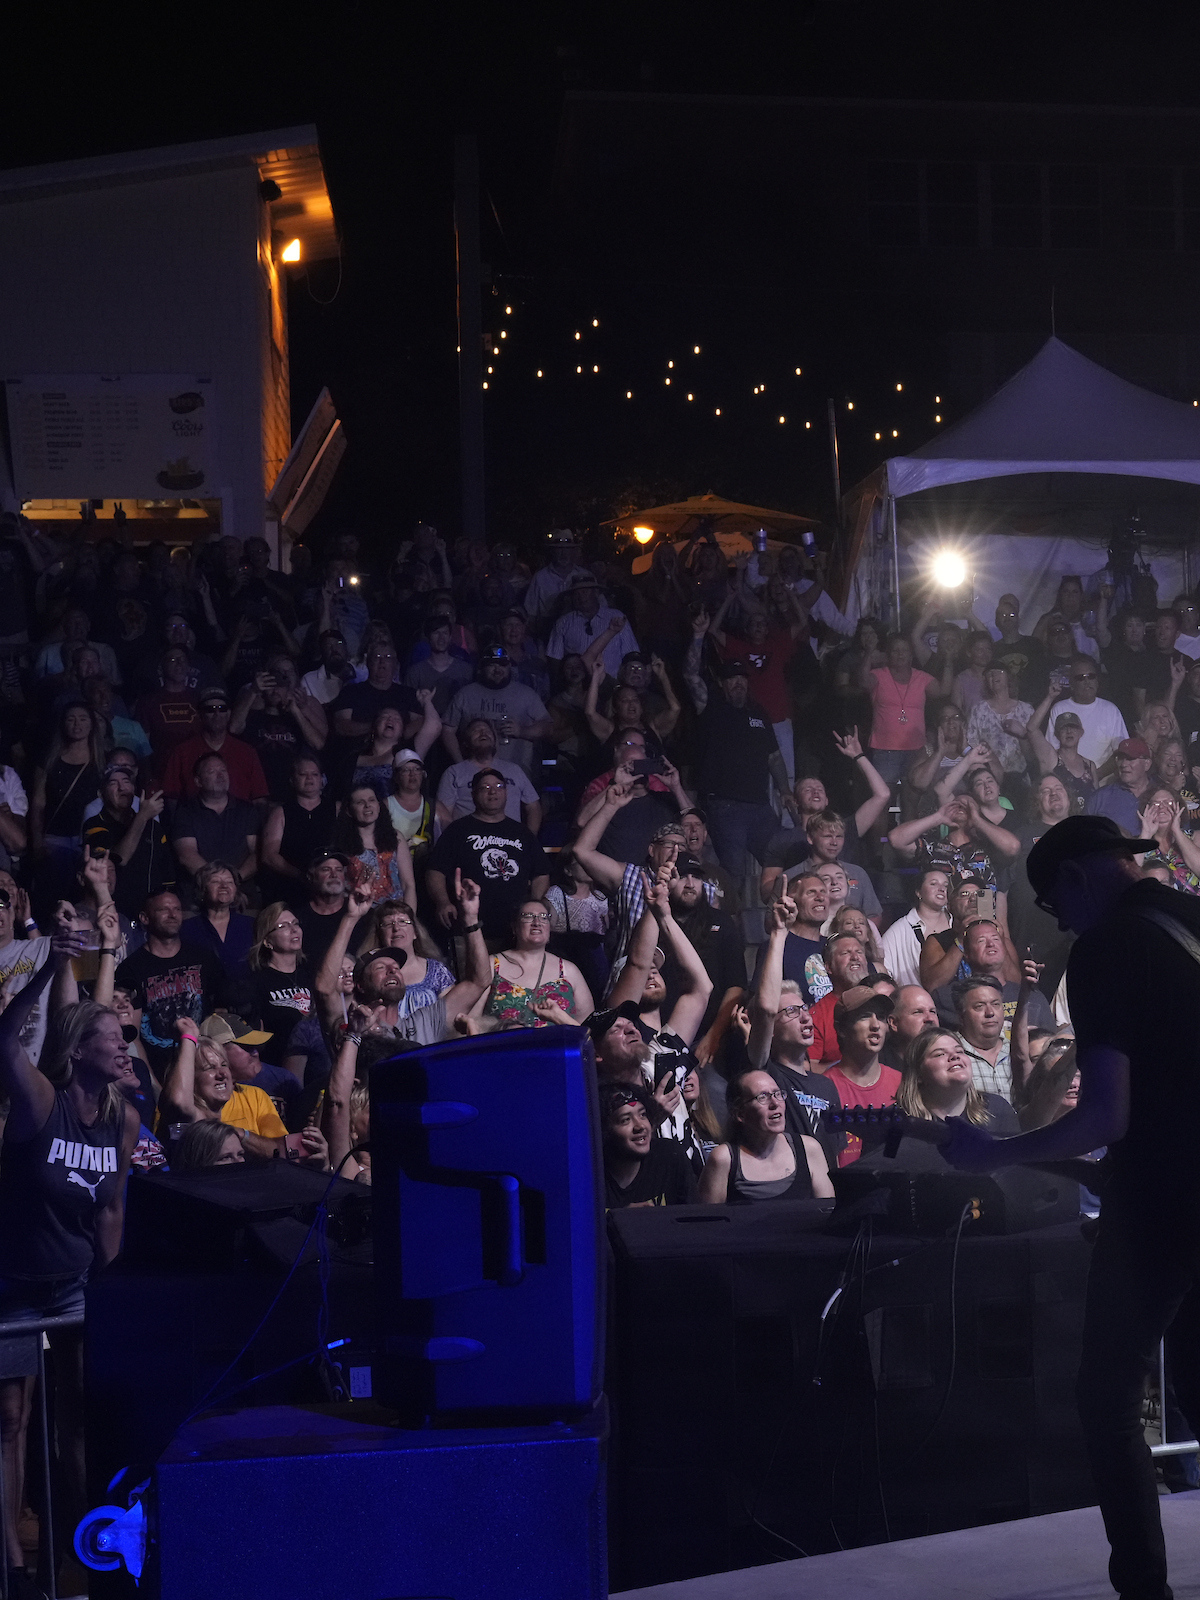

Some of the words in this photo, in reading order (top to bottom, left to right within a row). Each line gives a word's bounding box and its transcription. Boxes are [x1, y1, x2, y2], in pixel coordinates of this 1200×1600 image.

[480, 698, 491, 713] It's
[466, 835, 524, 852] Whitesnake
[46, 1137, 118, 1173] PUMA
